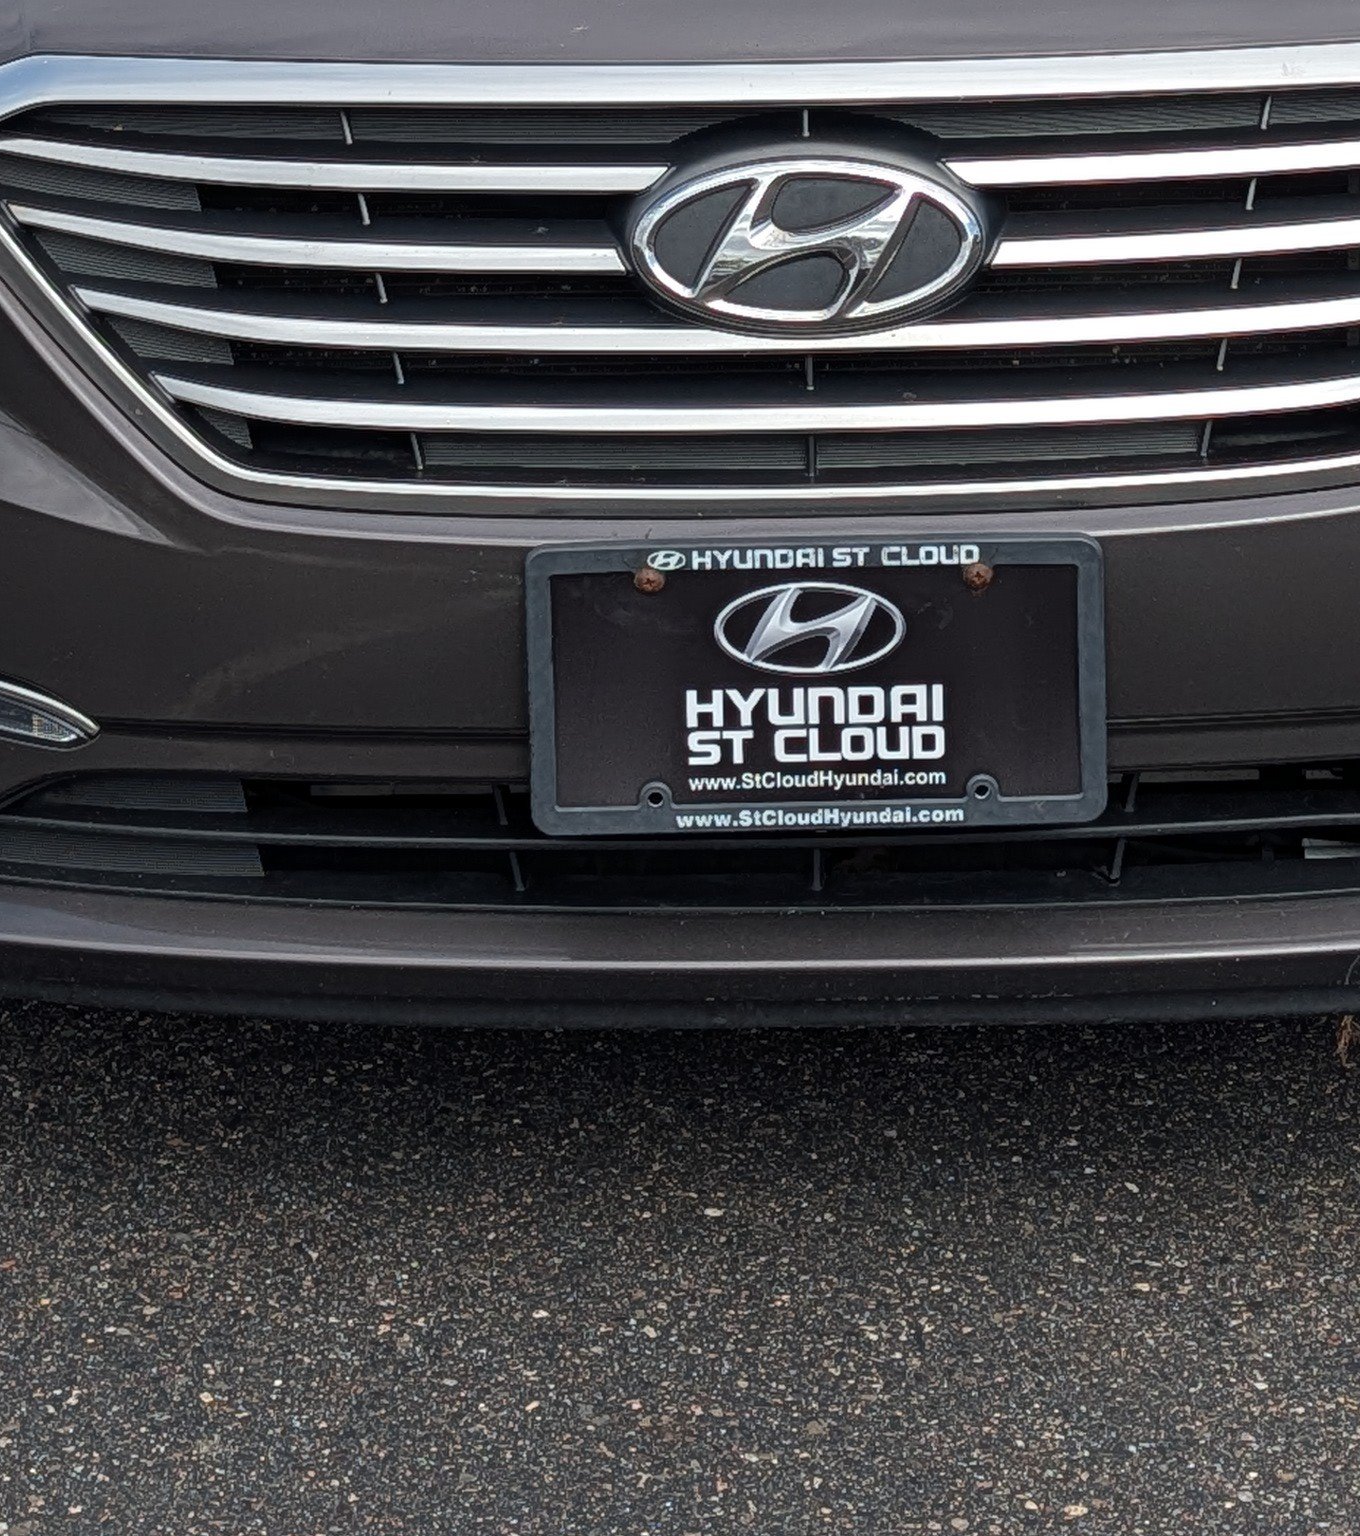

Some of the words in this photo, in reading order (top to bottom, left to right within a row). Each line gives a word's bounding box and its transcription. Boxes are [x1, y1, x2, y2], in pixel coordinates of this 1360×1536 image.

[692, 547, 825, 571] HYUNDAI
[832, 547, 870, 567] ST
[881, 544, 980, 566] CLOUD
[686, 683, 944, 728] HYUNDAI
[687, 729, 754, 766] ST
[773, 725, 946, 763] CLOUD
[688, 768, 946, 791] www.StCloudHyundai.com
[675, 807, 965, 829] www.StCloudHyundai.com
